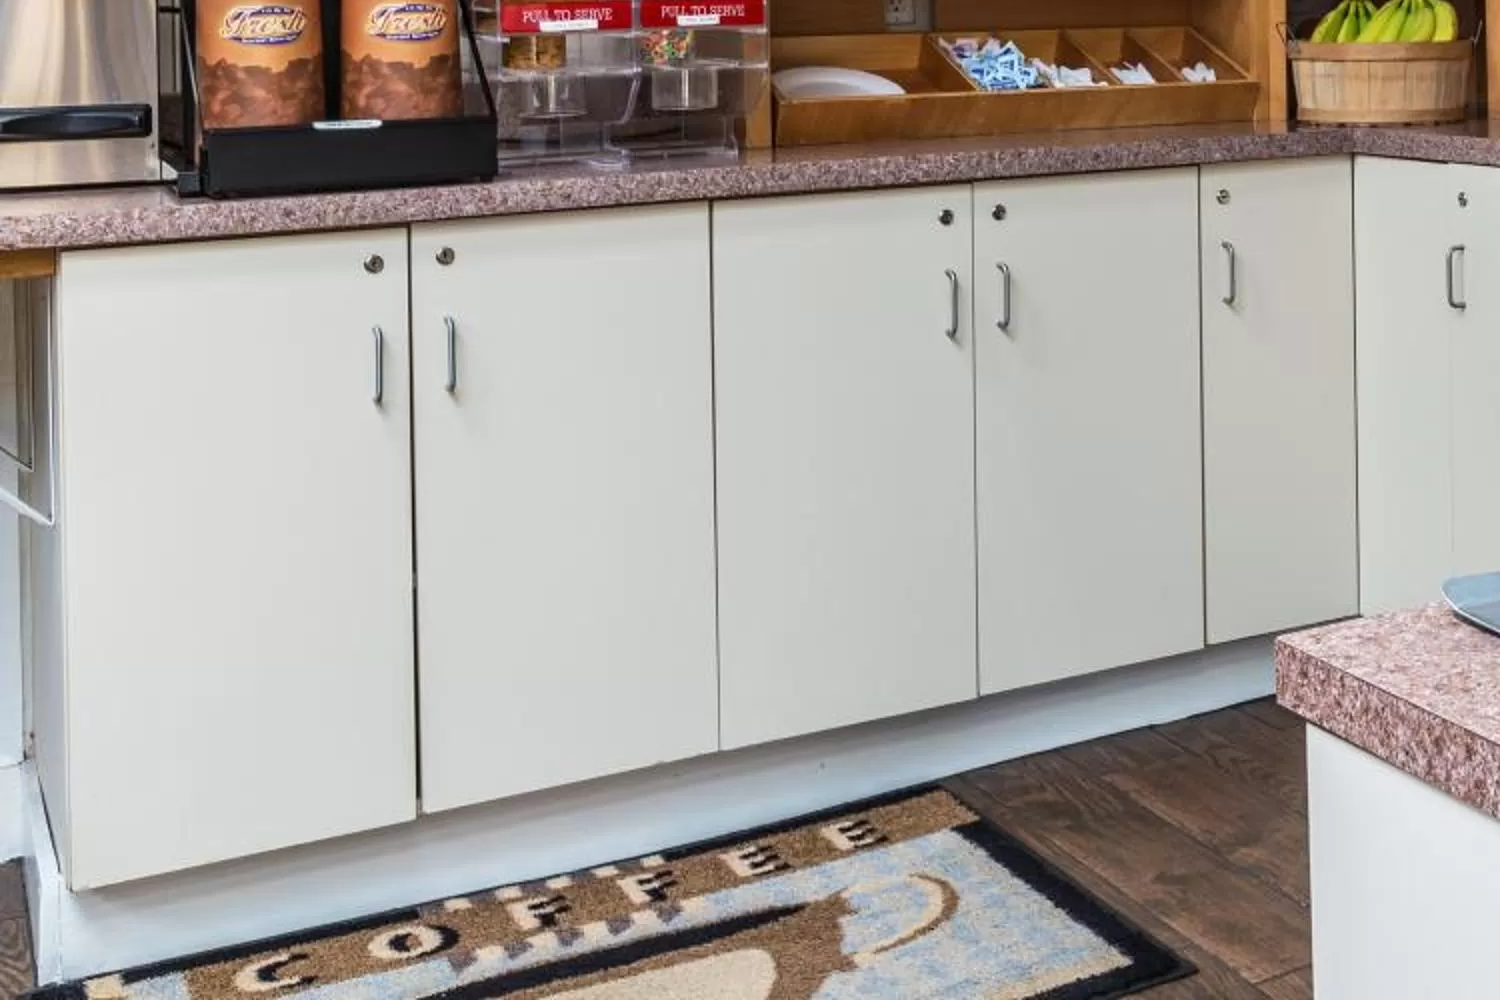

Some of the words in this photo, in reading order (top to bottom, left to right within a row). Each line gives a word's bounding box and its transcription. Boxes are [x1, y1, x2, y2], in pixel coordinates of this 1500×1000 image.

[522, 10, 550, 23] PULL
[553, 10, 570, 21] TO
[572, 8, 613, 22] SERVE
[661, 5, 689, 18] PULL
[691, 5, 708, 16] TO
[709, 4, 746, 17] SERVE
[234, 818, 888, 992] COFFEE
